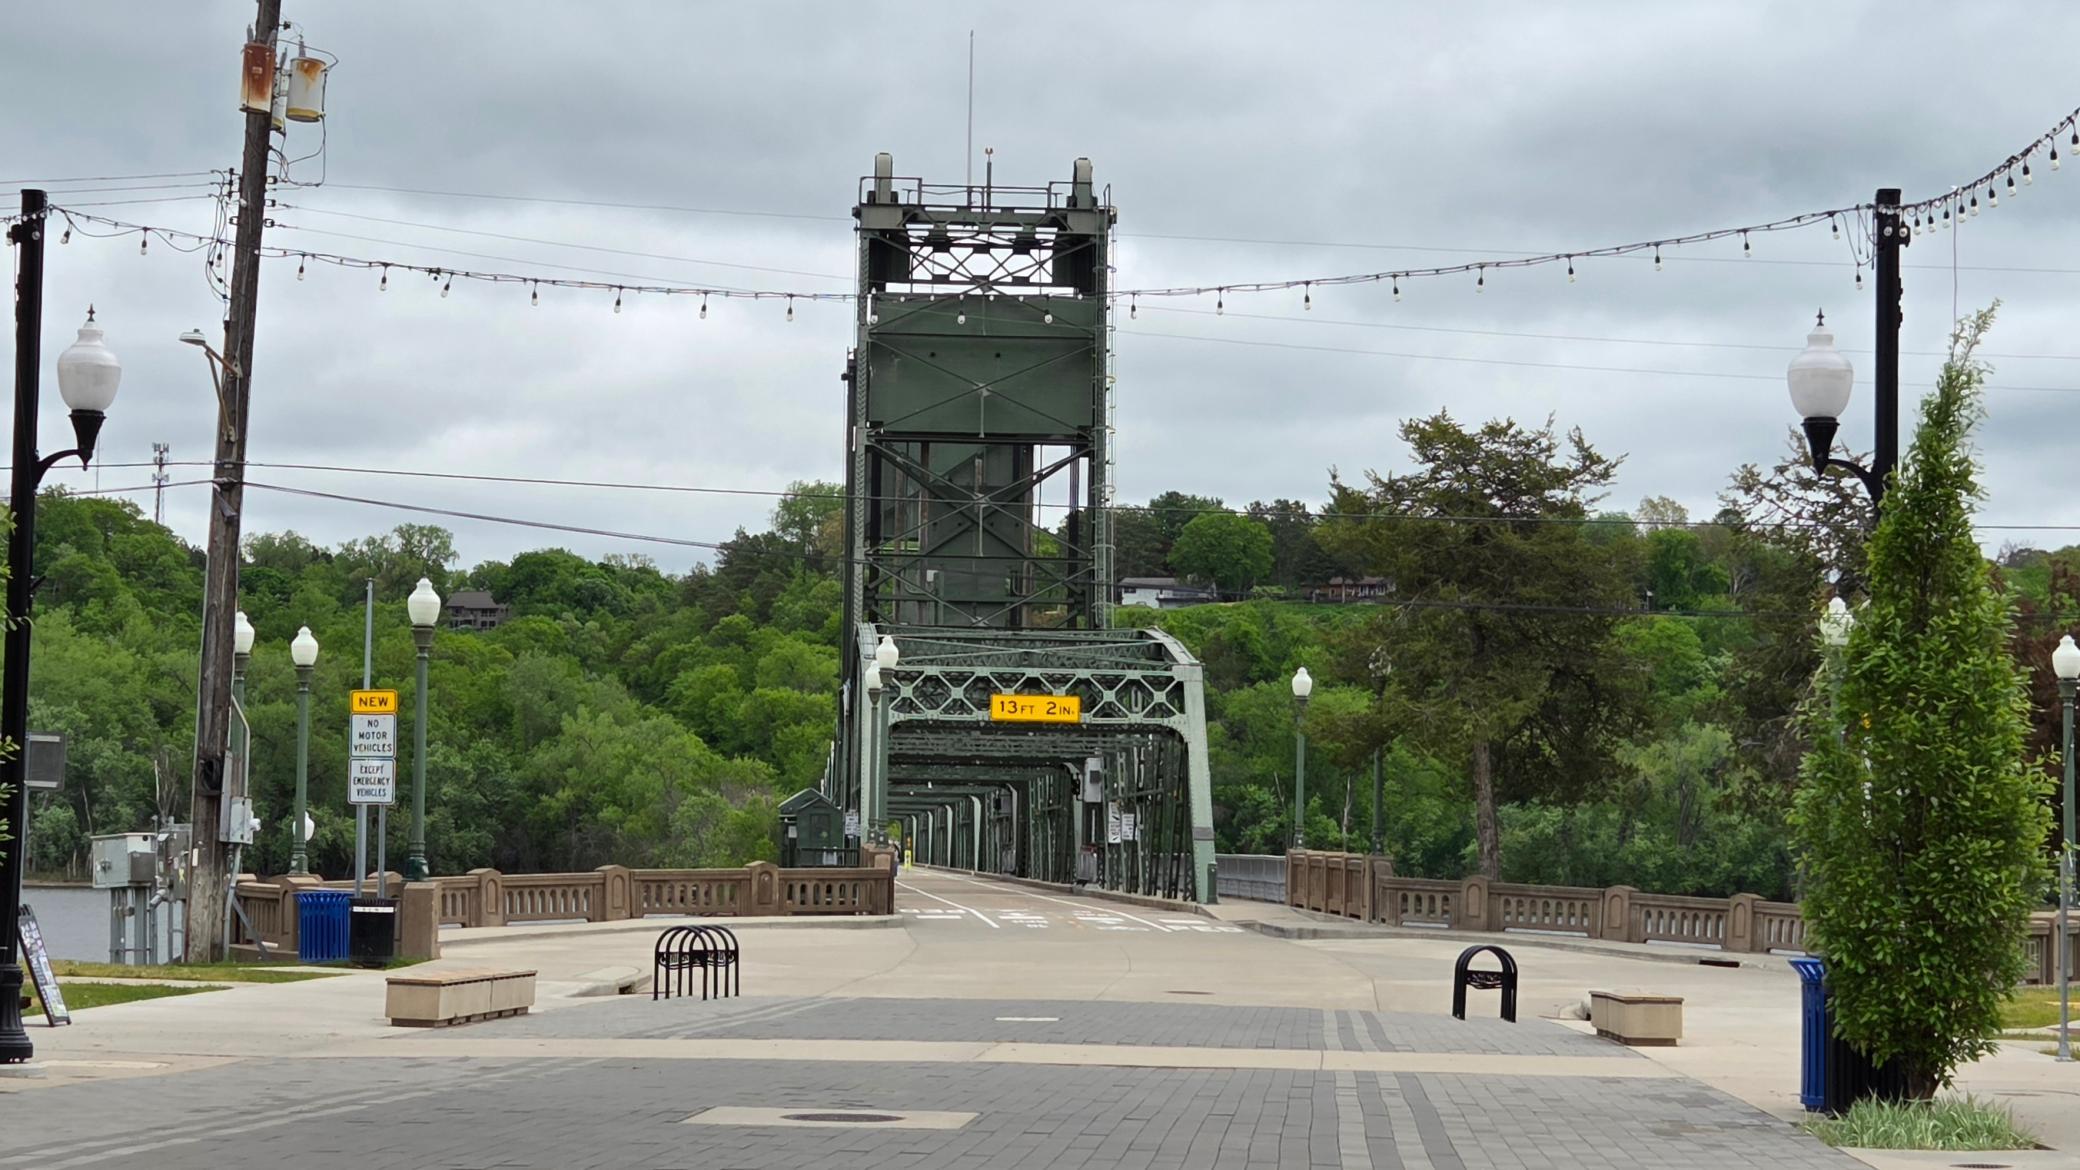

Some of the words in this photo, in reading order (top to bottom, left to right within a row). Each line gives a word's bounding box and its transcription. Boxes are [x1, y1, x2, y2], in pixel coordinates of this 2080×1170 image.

[359, 696, 388, 707] NEW
[367, 719, 379, 728] NO
[359, 731, 387, 740] MOTOR
[353, 743, 392, 752] VEHICLES
[360, 765, 384, 774] EXCEPT
[357, 788, 386, 797] VEHICLES
